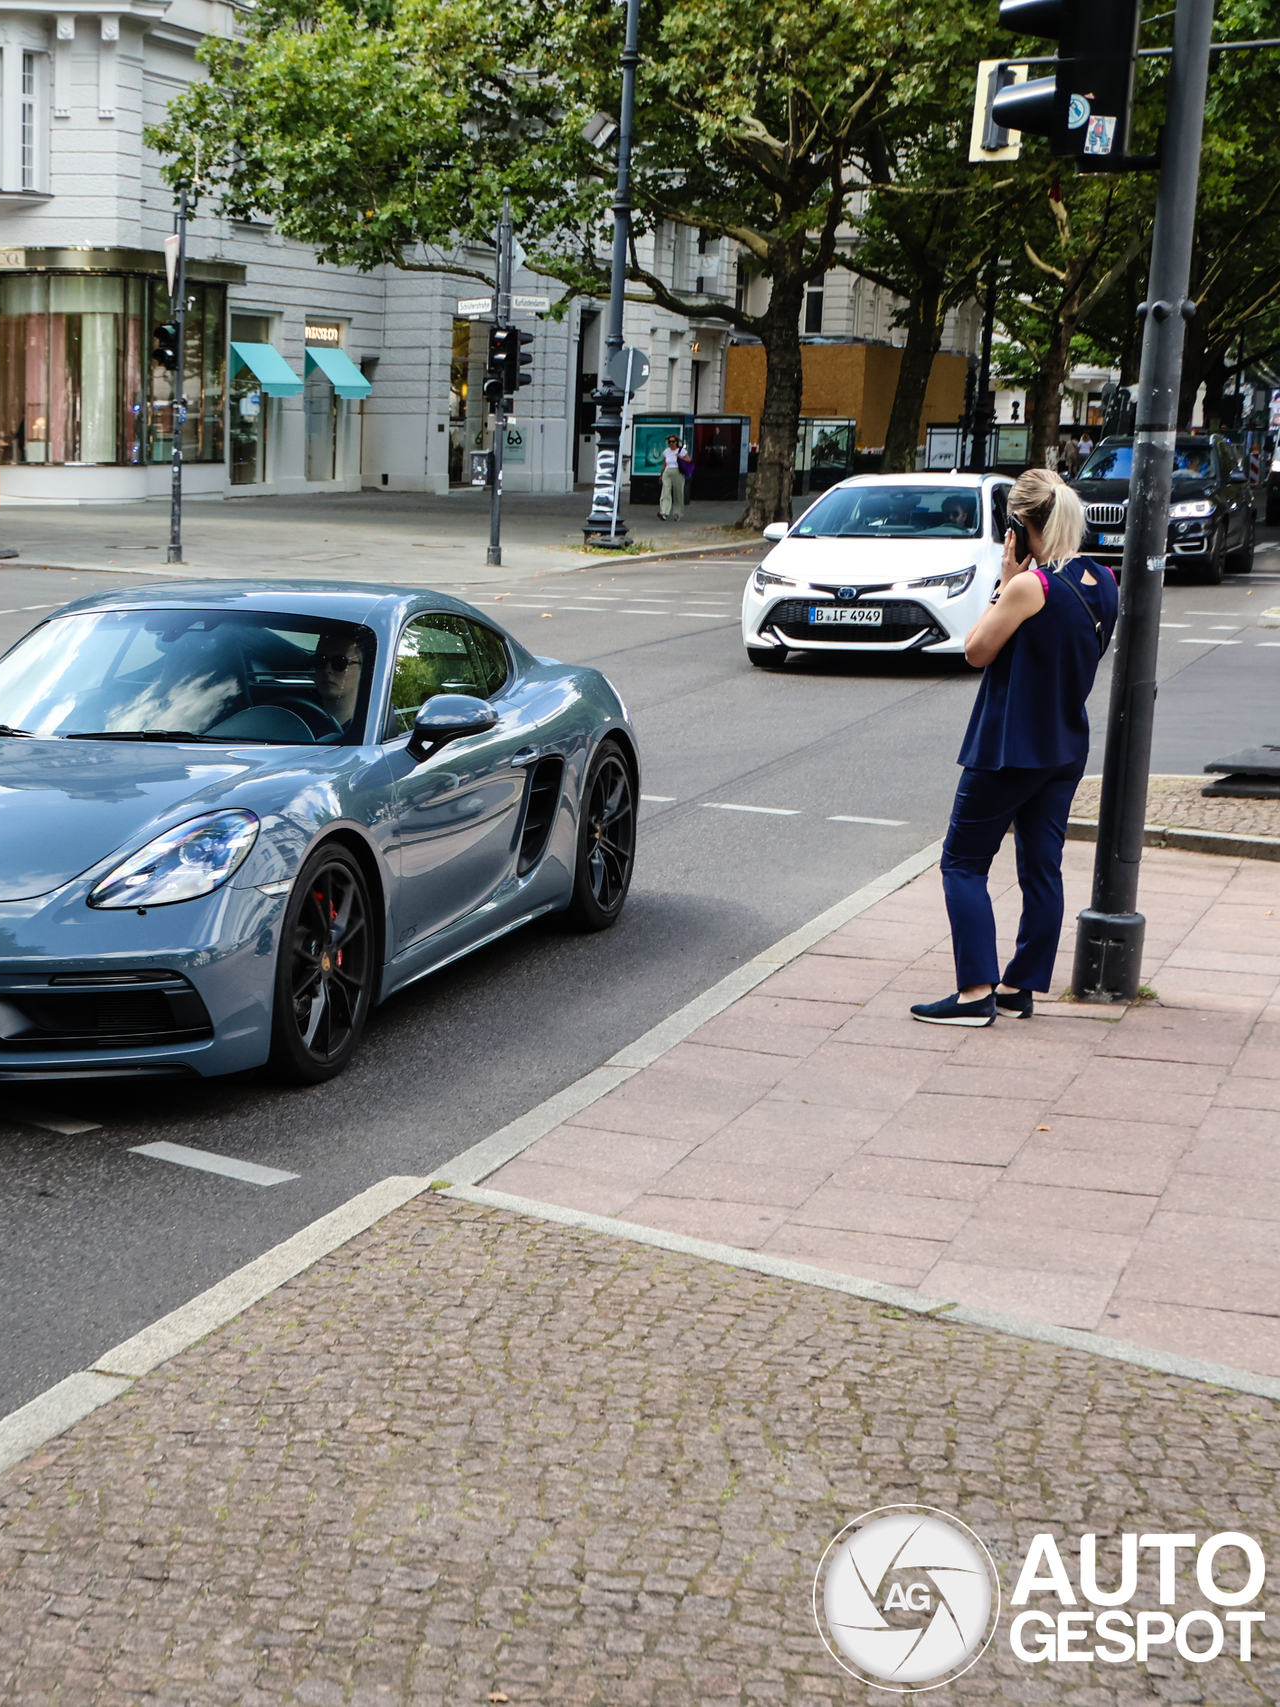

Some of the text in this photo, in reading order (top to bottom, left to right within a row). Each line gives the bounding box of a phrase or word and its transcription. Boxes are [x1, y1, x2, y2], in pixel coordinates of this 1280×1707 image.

[460, 300, 490, 311] Schlüterstraße
[515, 299, 546, 308] Kurfürstendamm
[816, 609, 881, 622] B IF 4949
